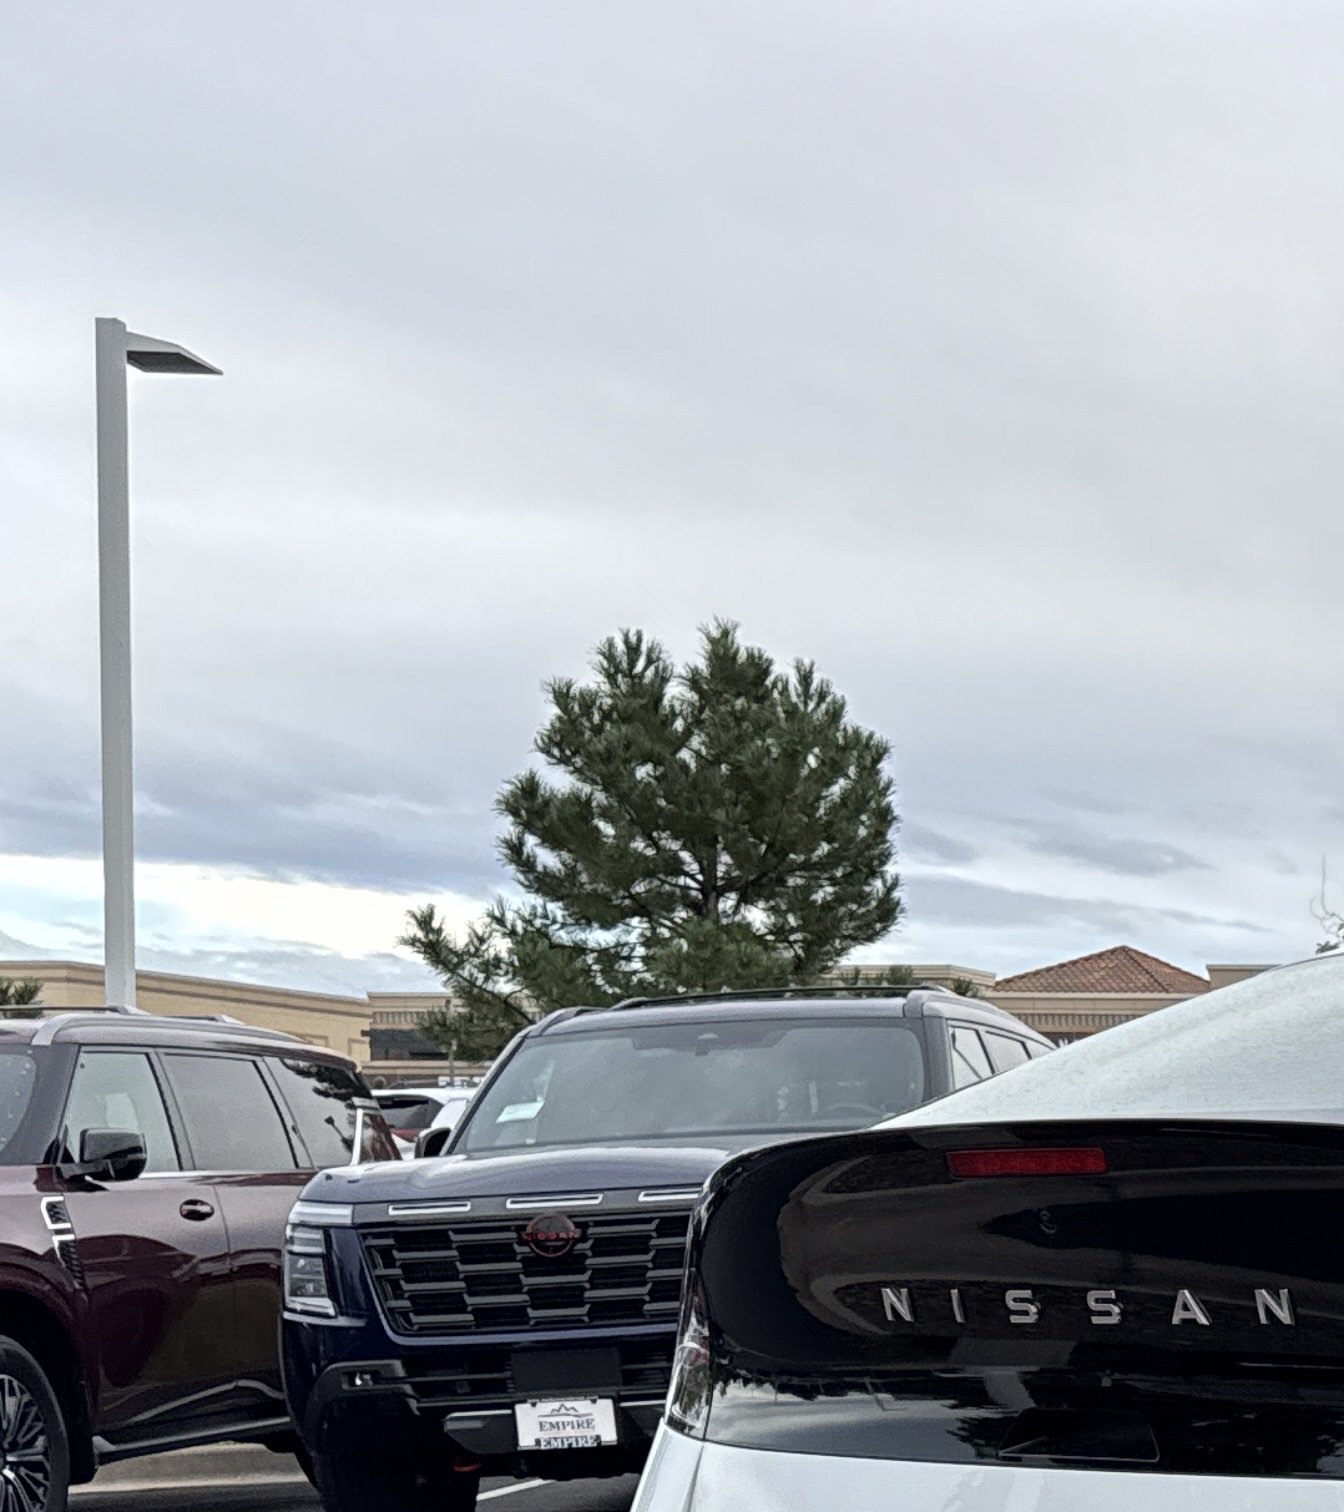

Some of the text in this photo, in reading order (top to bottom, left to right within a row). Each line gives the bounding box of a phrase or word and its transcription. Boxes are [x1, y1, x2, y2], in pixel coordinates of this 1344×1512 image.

[881, 1288, 1296, 1325] NISSAN
[539, 1418, 595, 1432] EMPIRE
[541, 1434, 597, 1450] EMPIRE
